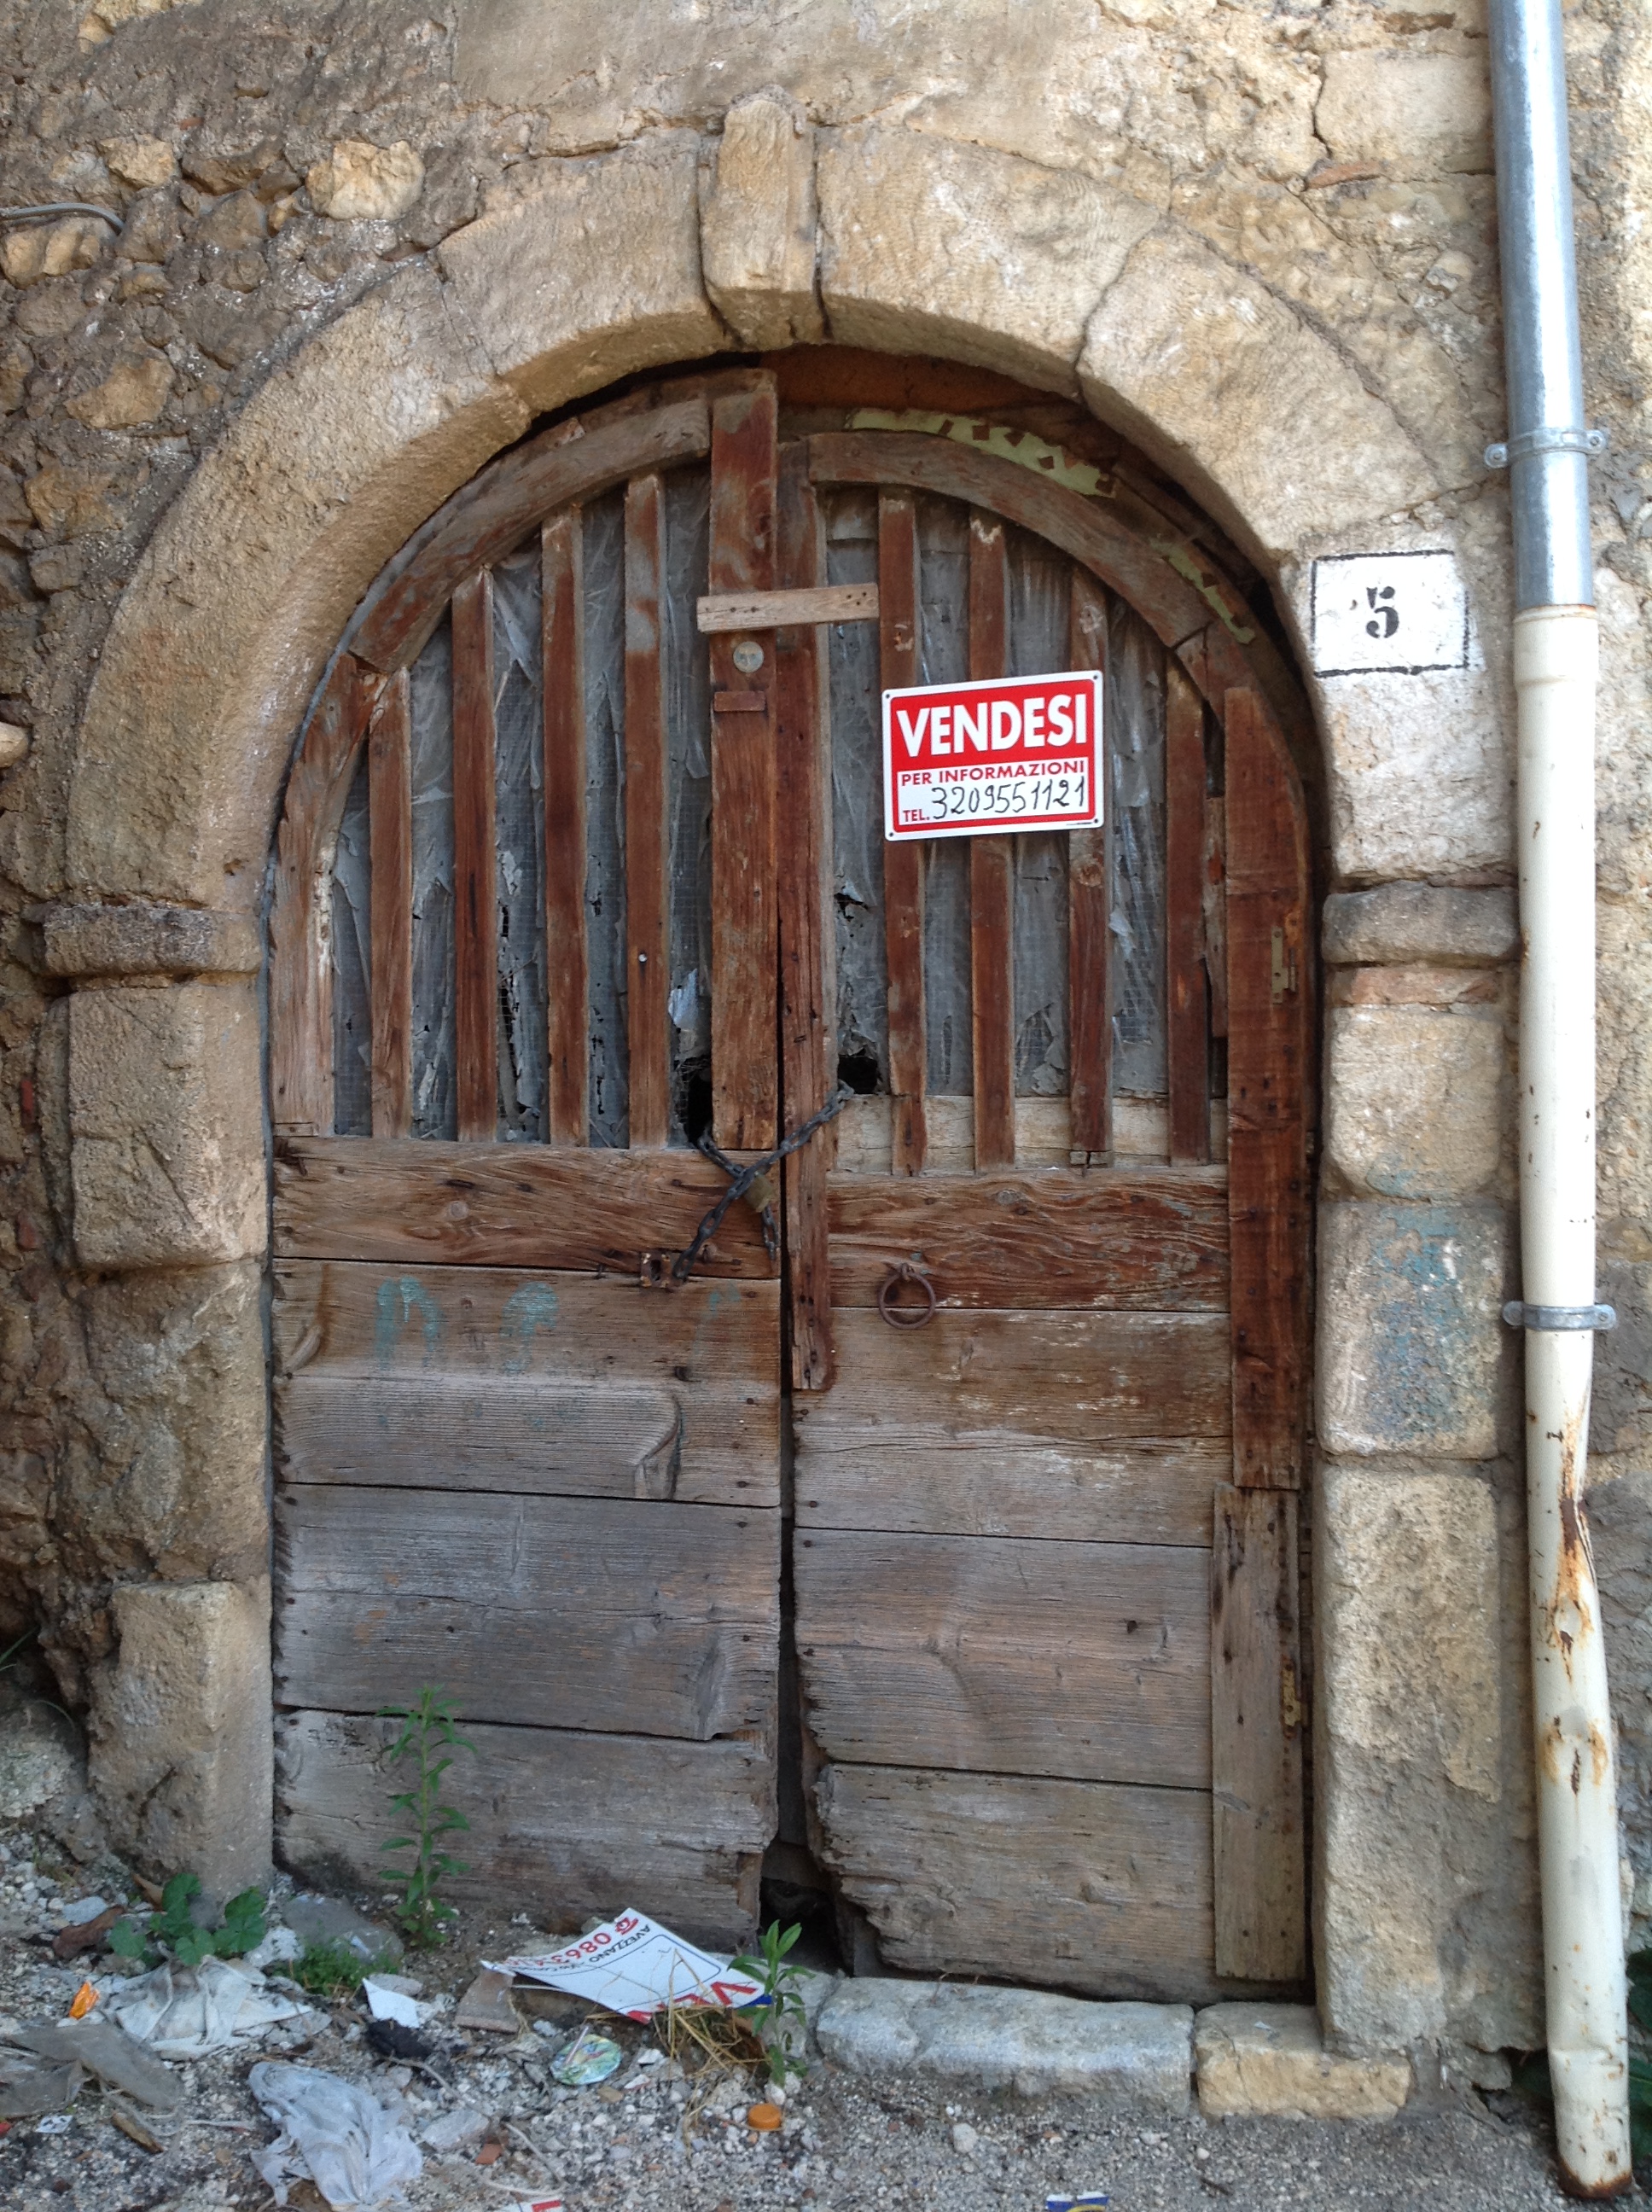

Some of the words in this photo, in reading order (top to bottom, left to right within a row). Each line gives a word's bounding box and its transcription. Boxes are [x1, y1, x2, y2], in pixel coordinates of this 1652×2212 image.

[1365, 585, 1399, 639] 5
[896, 694, 1087, 758] VENDESI
[901, 771, 933, 787] PER
[939, 760, 1085, 783] INFORMAZIONI
[902, 808, 931, 823] TEL.
[931, 775, 1085, 820] 3209551121
[589, 1924, 651, 1963] AVEZZANO
